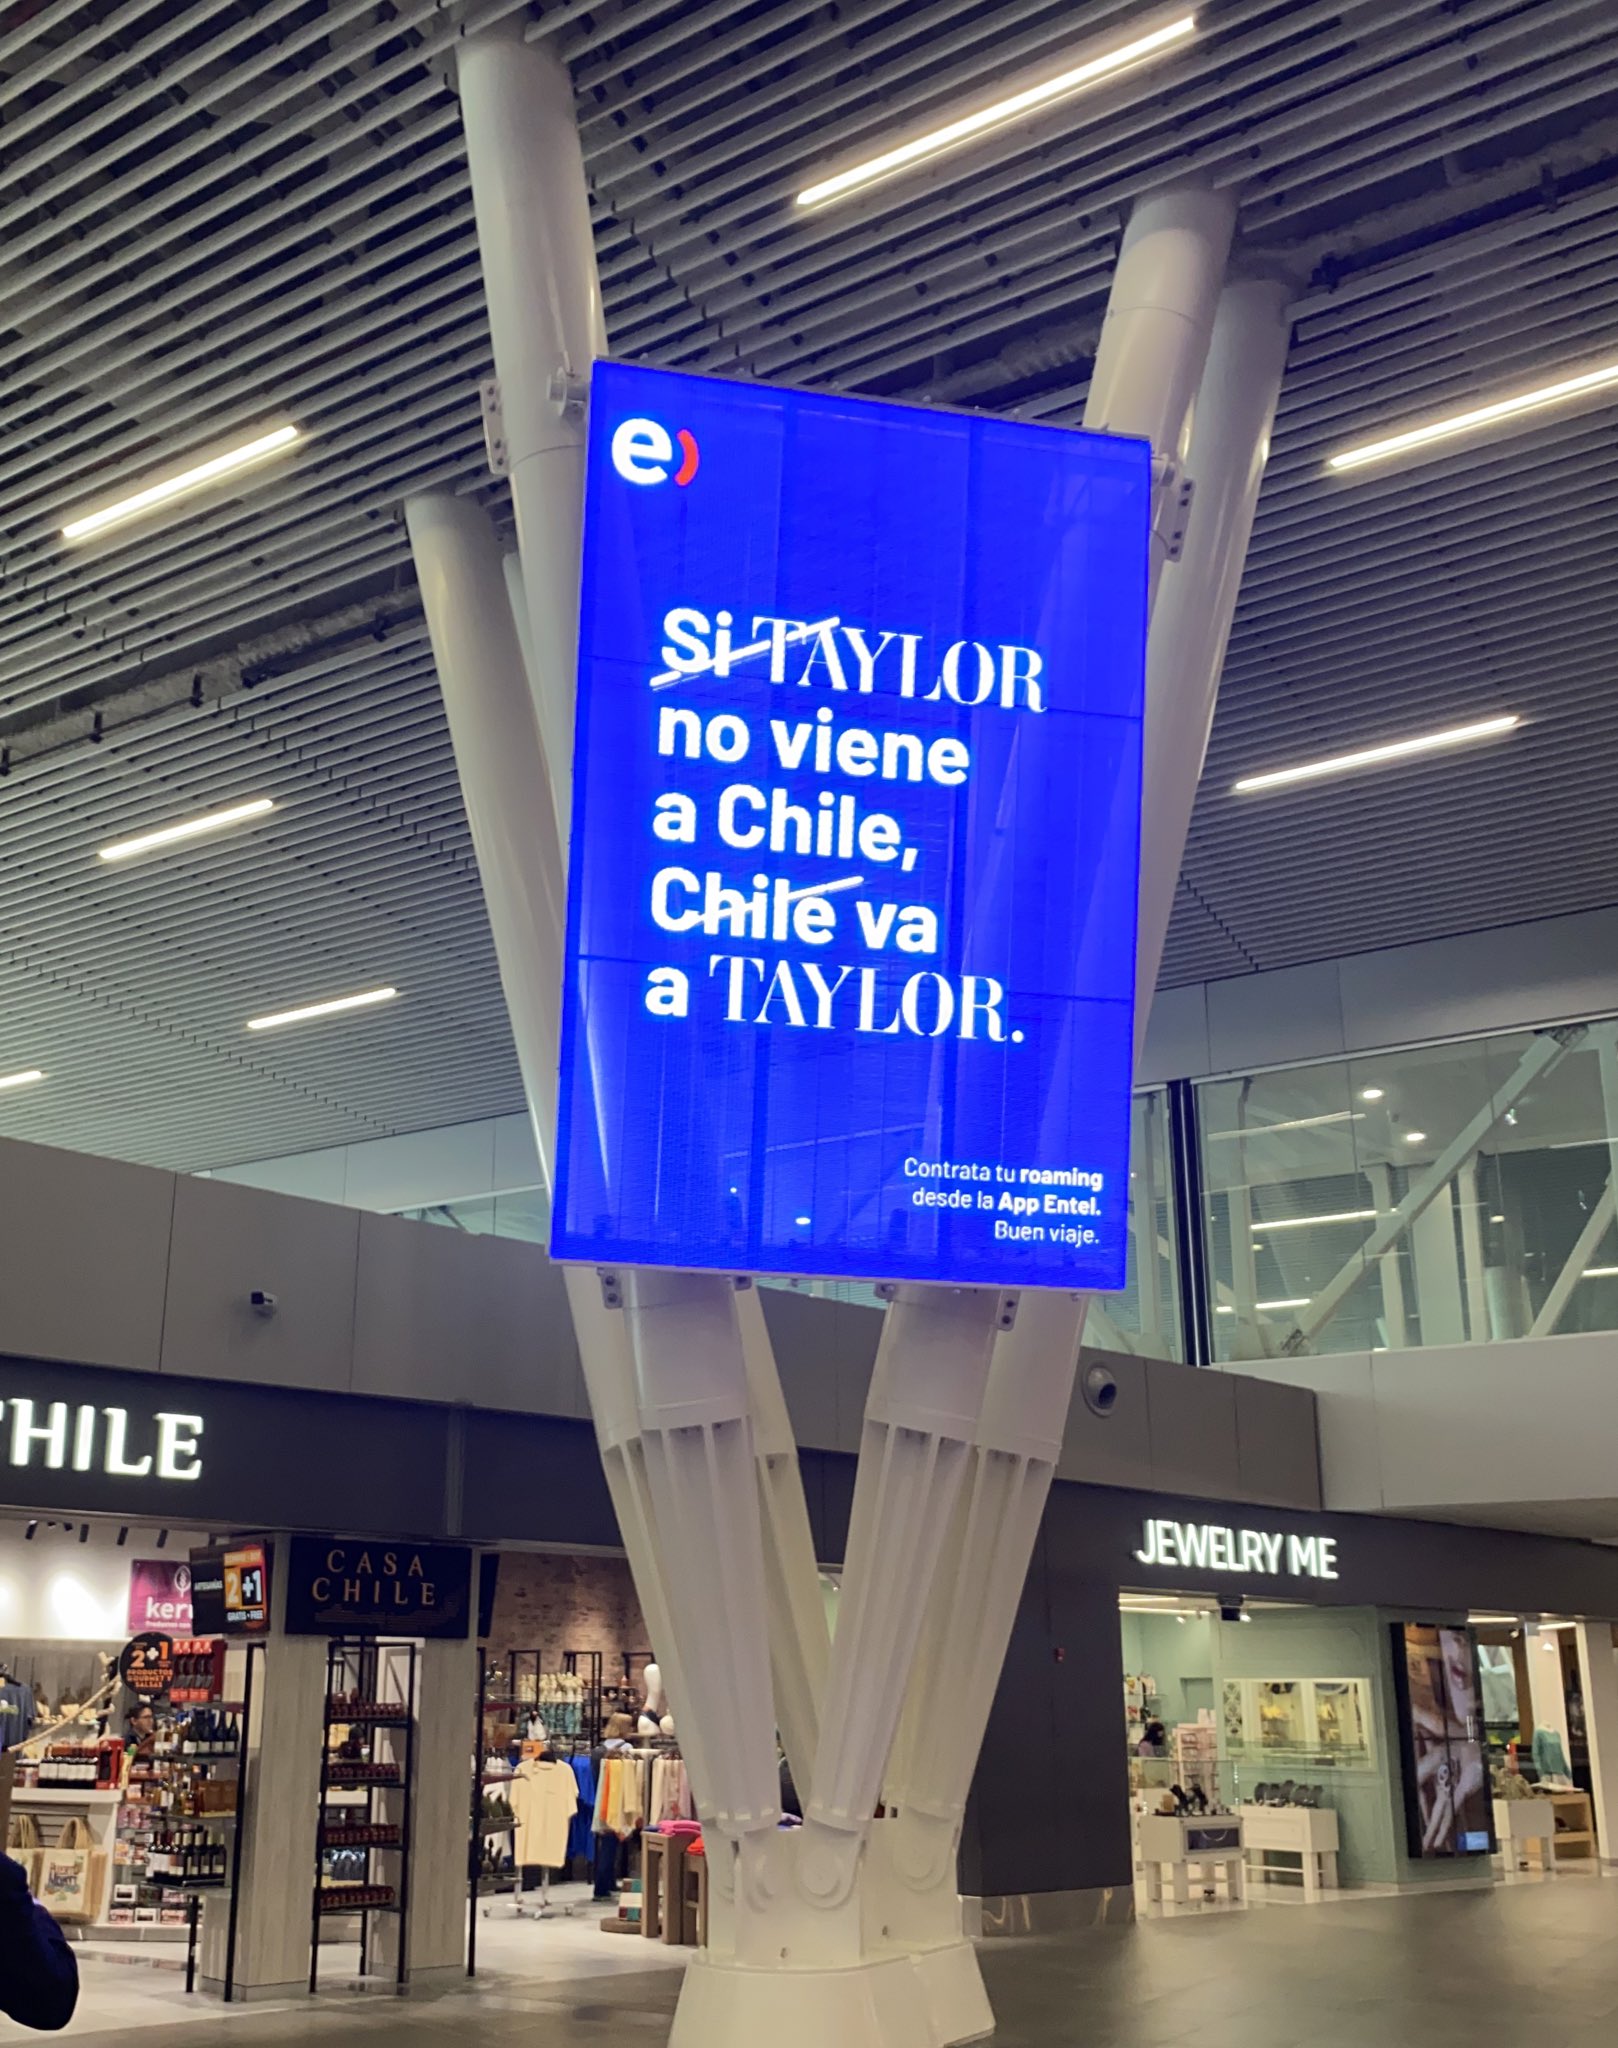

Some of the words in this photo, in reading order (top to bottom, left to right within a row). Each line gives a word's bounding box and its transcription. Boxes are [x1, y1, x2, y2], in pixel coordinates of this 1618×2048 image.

[662, 607, 733, 678] Si
[752, 616, 1047, 713] TAYLOR
[658, 706, 751, 763] no
[770, 707, 970, 785] viene
[652, 792, 697, 843] a
[718, 783, 918, 872] Chile,
[651, 866, 837, 944] Chile
[856, 901, 938, 954] va
[645, 966, 690, 1017] a
[709, 954, 1025, 1043] TAYLOR.
[904, 1156, 991, 1182] Contrata
[995, 1164, 1016, 1183] tu
[1019, 1167, 1104, 1192] roaming
[912, 1187, 973, 1209] desde
[977, 1190, 994, 1210] la
[998, 1191, 1041, 1216] App
[1044, 1194, 1102, 1216] Entel.
[994, 1220, 1045, 1241] Buen
[1049, 1223, 1100, 1248] viaje.
[0, 1397, 204, 1480] HILE
[326, 1549, 424, 1577] CASA
[1134, 1518, 1283, 1575] JEWELRY
[1286, 1534, 1339, 1580] ME
[311, 1577, 435, 1606] CHILE
